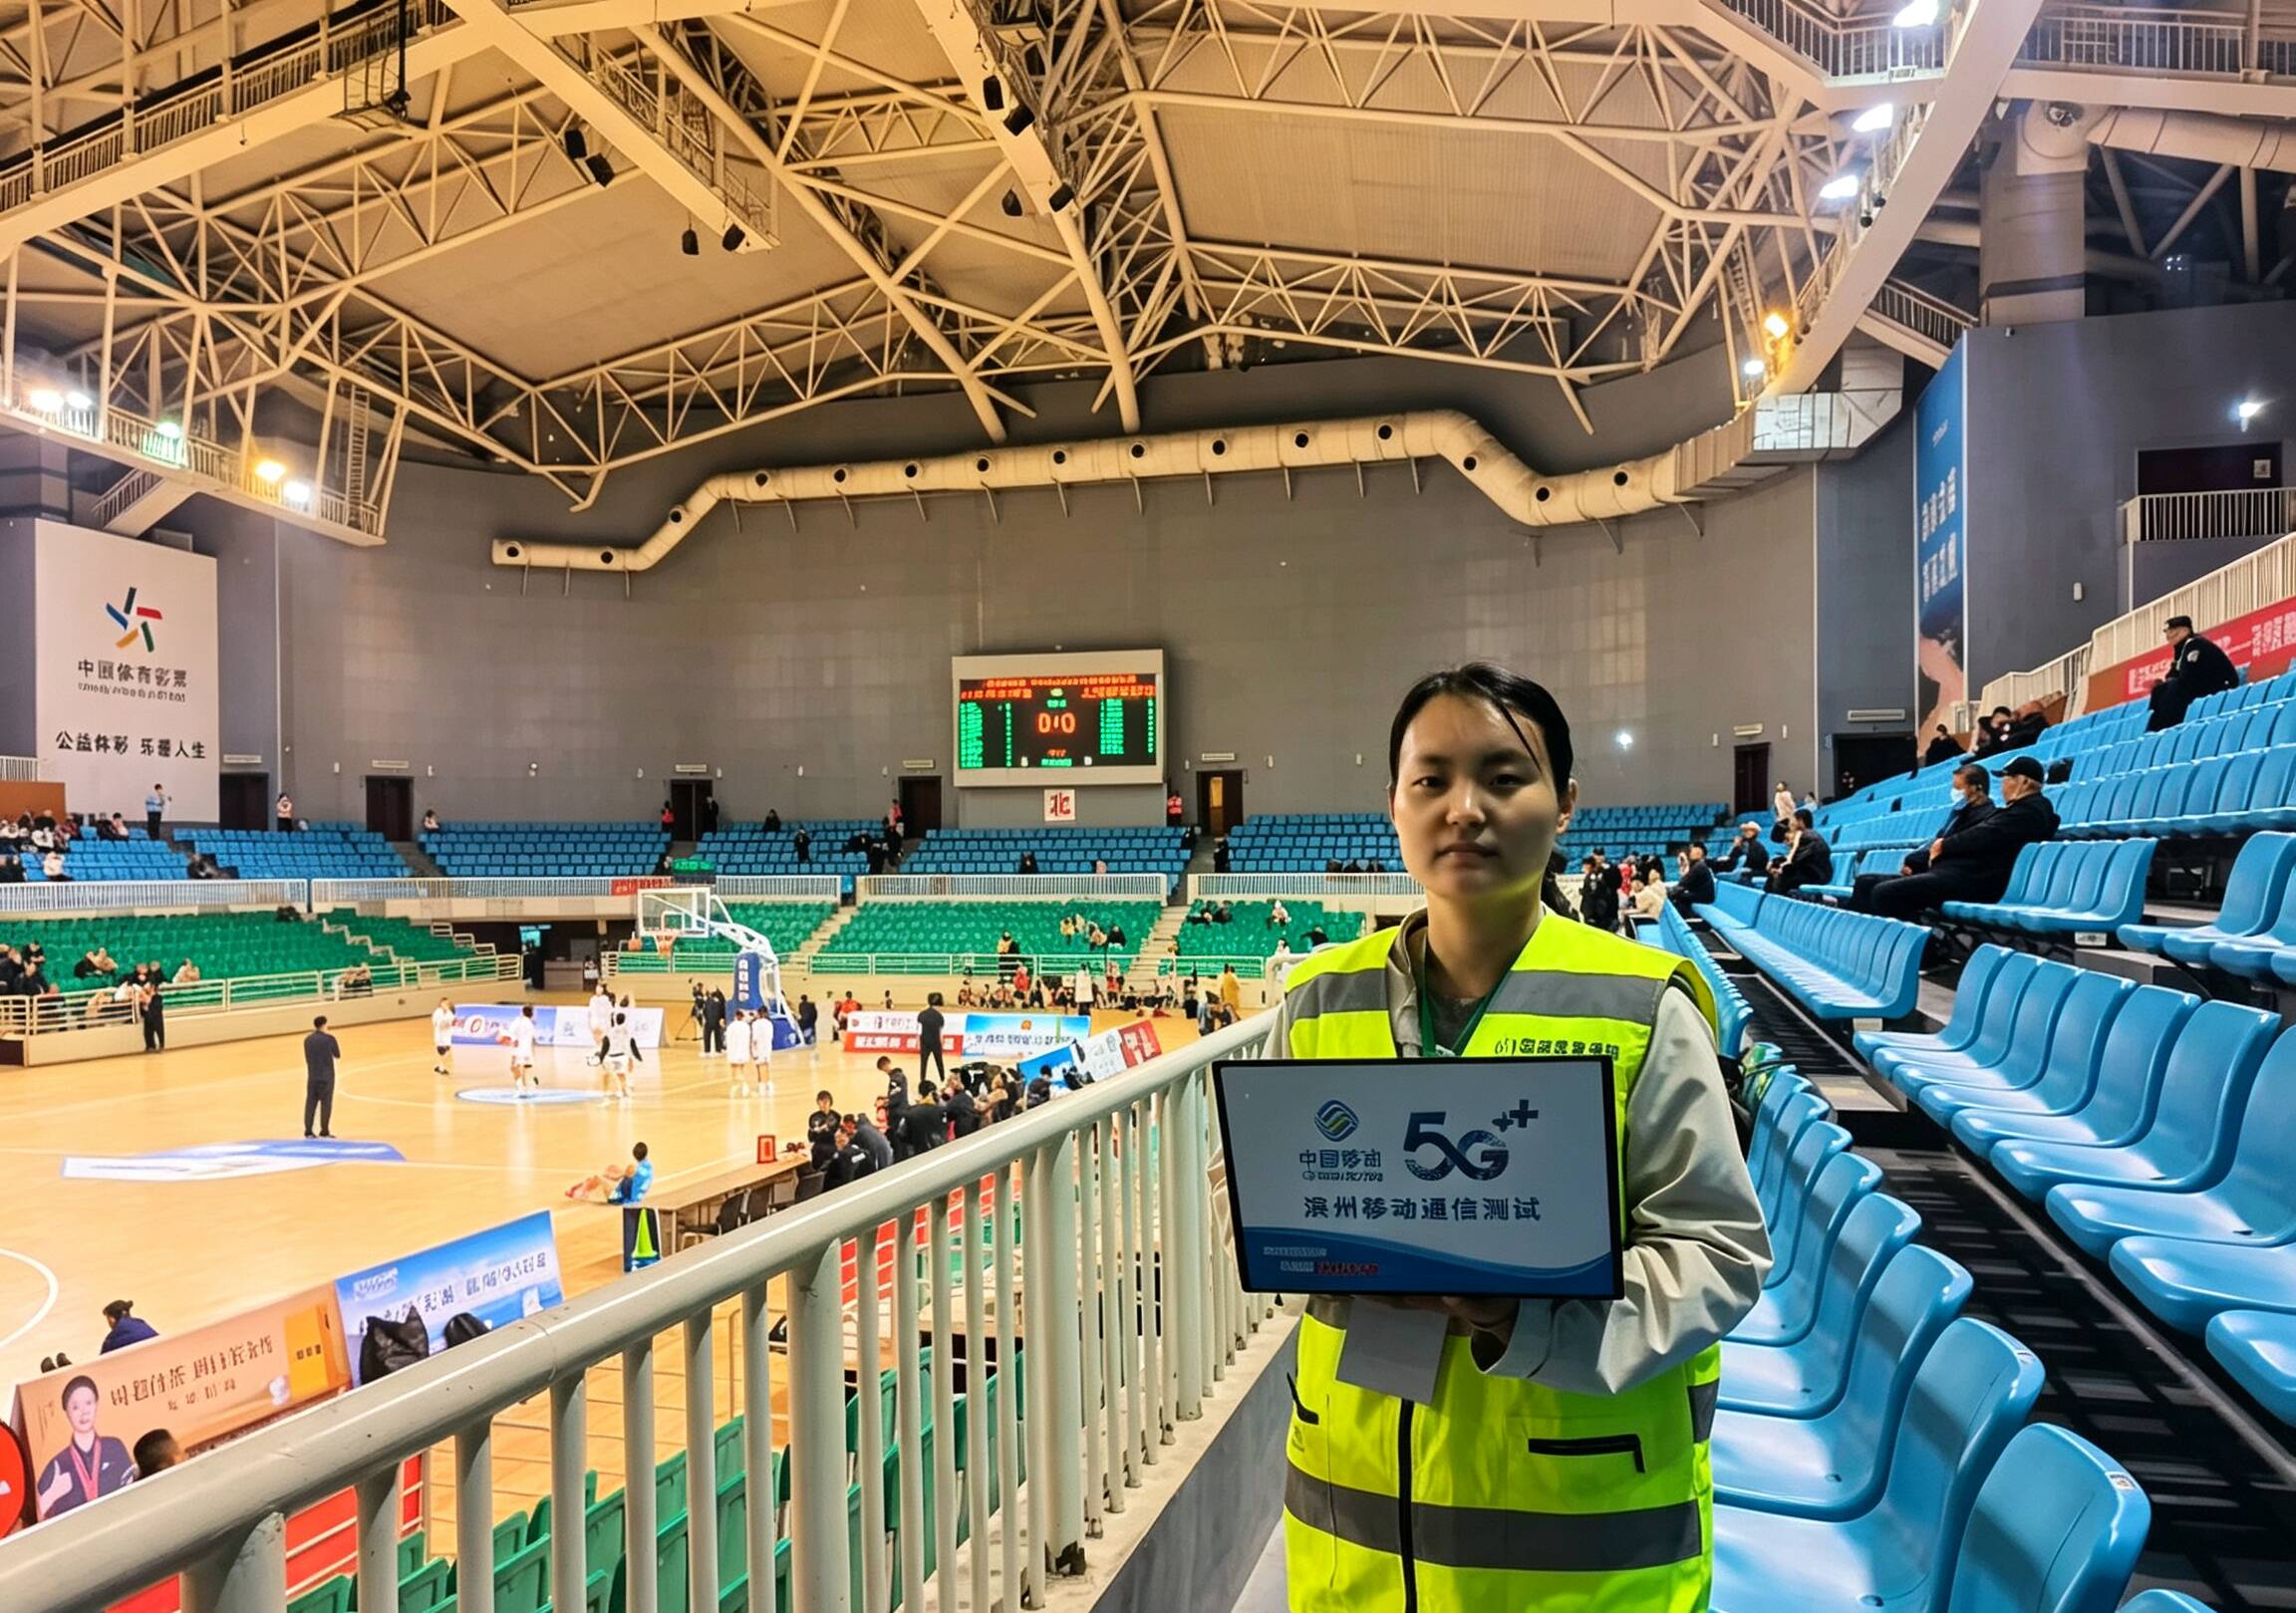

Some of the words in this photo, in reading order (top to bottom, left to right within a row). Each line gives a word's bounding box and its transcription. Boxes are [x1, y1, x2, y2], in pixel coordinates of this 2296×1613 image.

[1050, 792, 1071, 817] 北
[1303, 1196, 1542, 1221] 滨州移动通信测试
